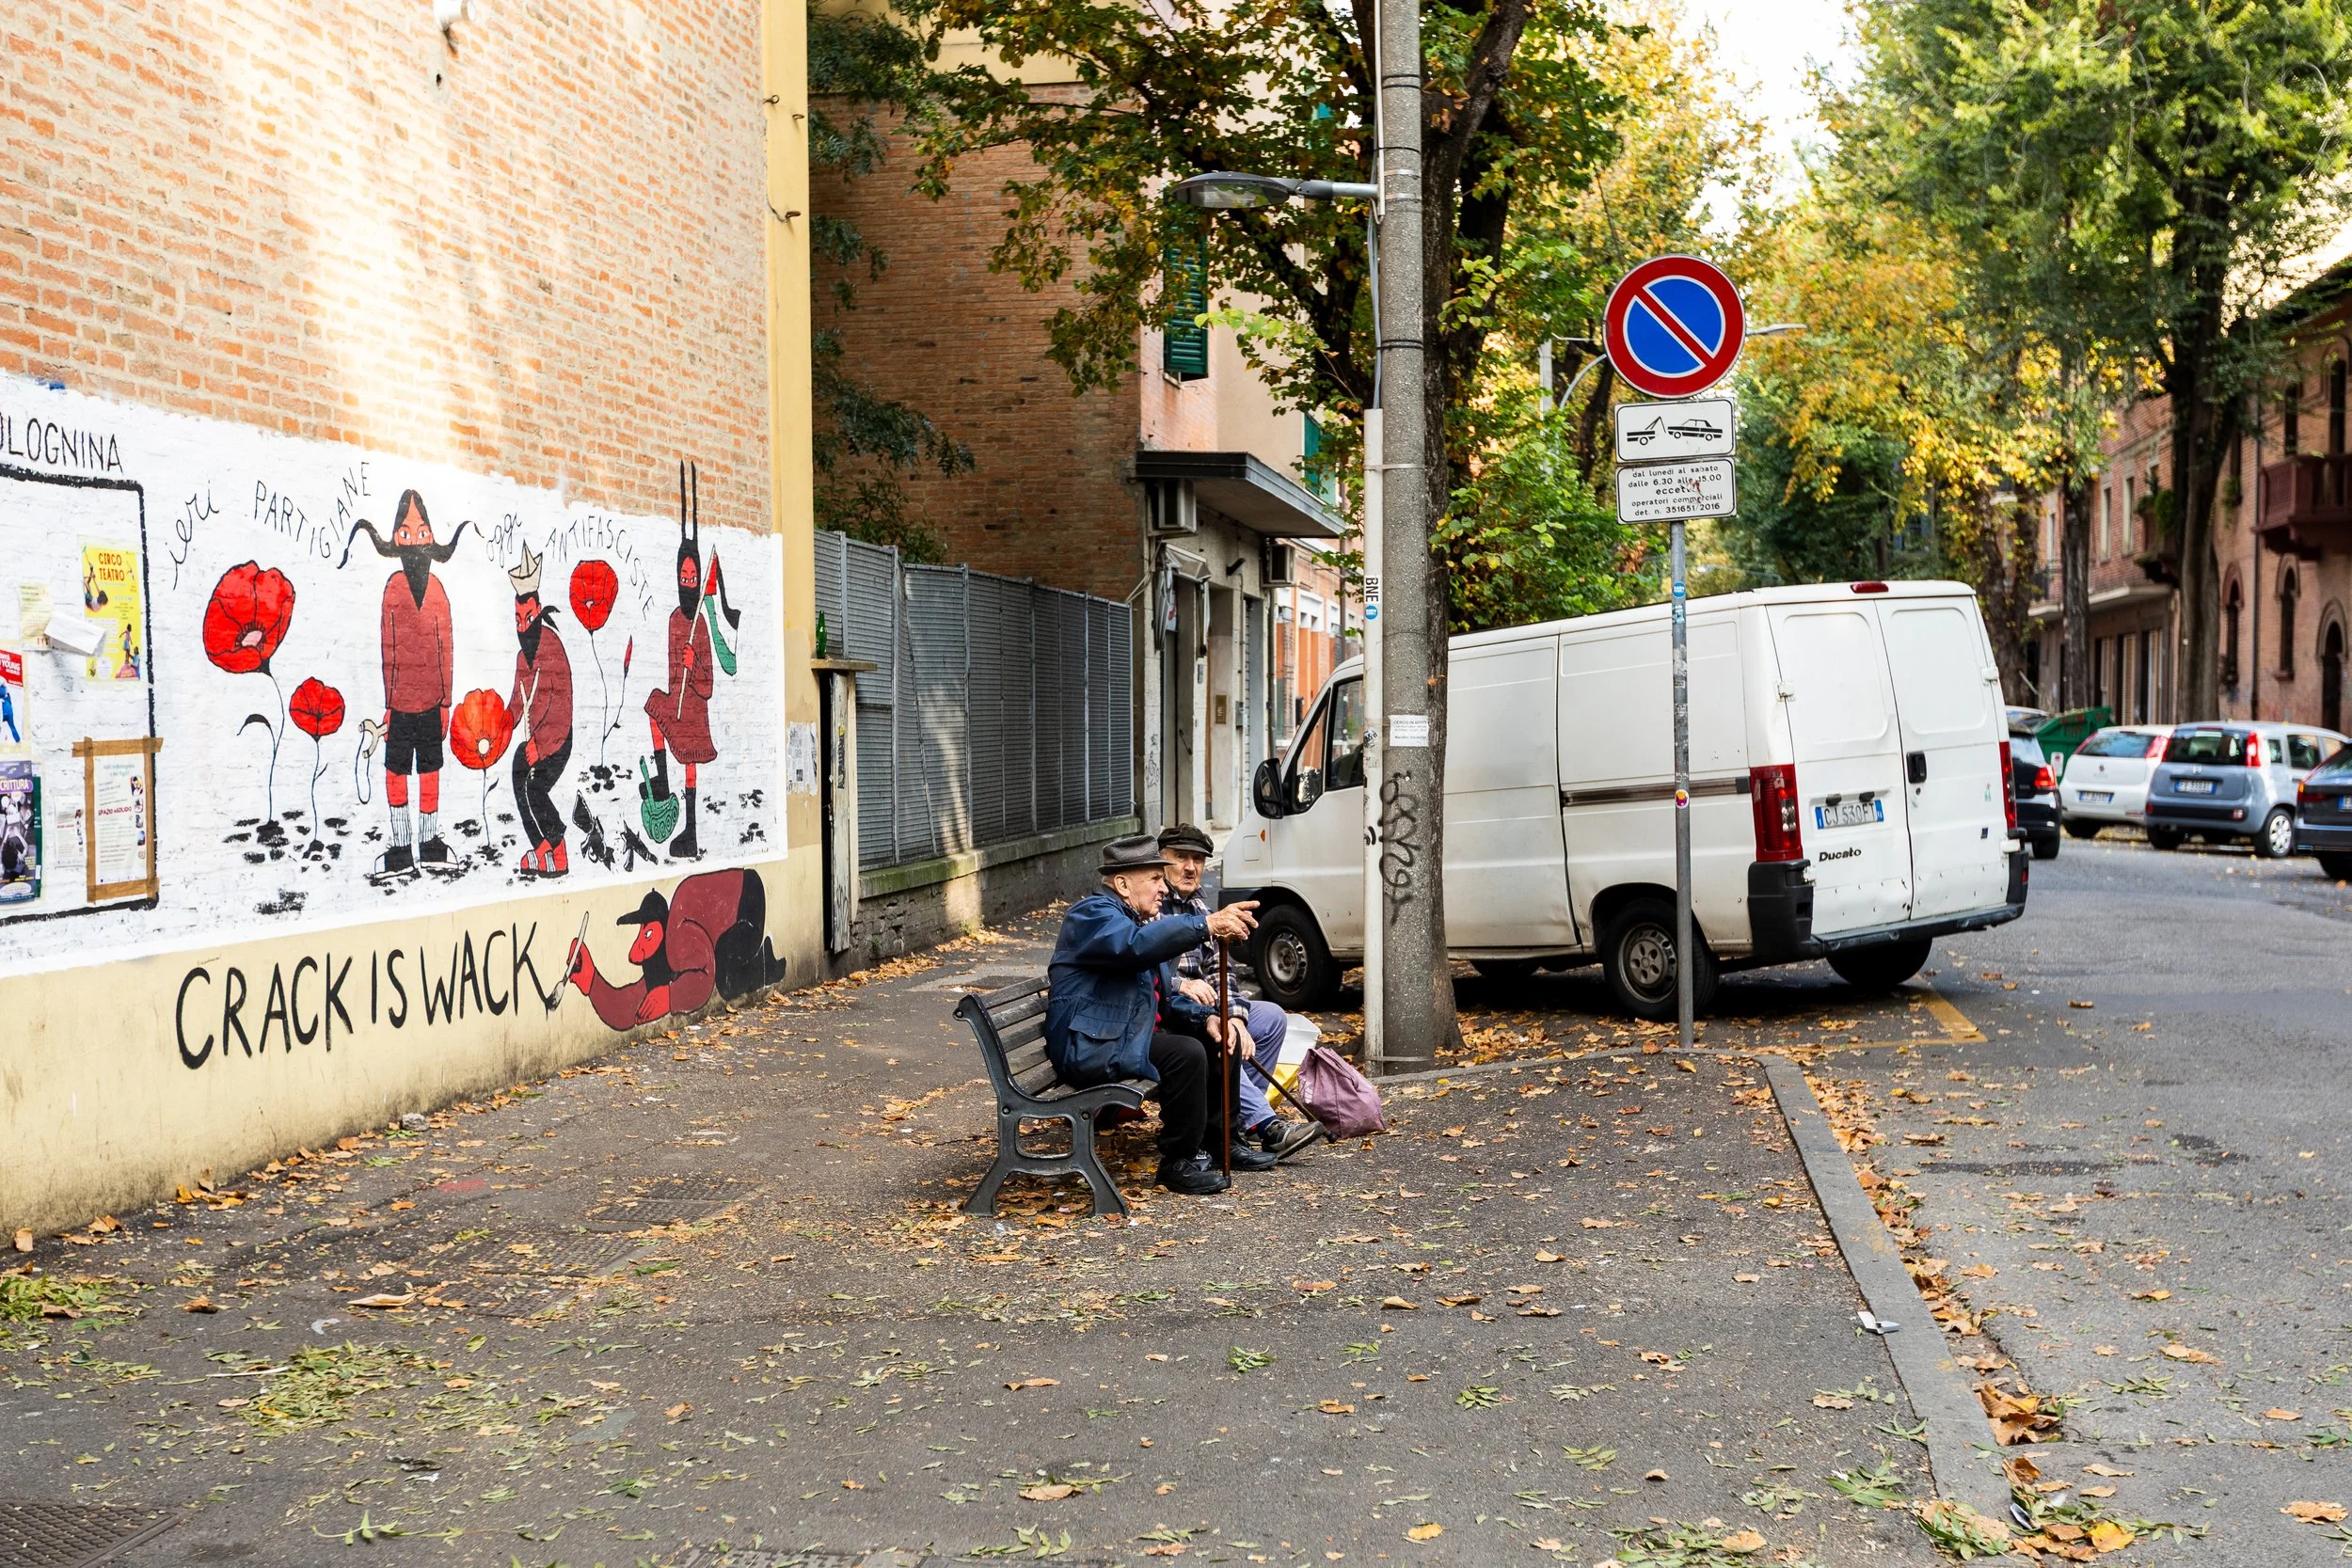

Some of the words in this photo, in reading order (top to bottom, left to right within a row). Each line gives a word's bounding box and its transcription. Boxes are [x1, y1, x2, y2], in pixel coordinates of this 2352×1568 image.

[0, 411, 123, 473] LOGNINA
[1653, 478, 1673, 486] 6.30
[1697, 473, 1722, 483] 15.00
[1631, 498, 1669, 508] operatori
[1673, 493, 1723, 503] commerciali
[1666, 502, 1721, 514] 351651/2016
[254, 462, 371, 559] PARTIGIANE
[98, 552, 122, 565] CIRCO
[99, 567, 125, 581] TEATRO
[546, 515, 656, 621] ANTIFASCISTE
[1365, 578, 1379, 602] BNE
[1824, 806, 1838, 826] CJ
[1819, 847, 1862, 863] Ducato
[176, 951, 355, 1069] CRACK
[371, 948, 407, 1029] IS
[420, 921, 552, 1026] WACK
